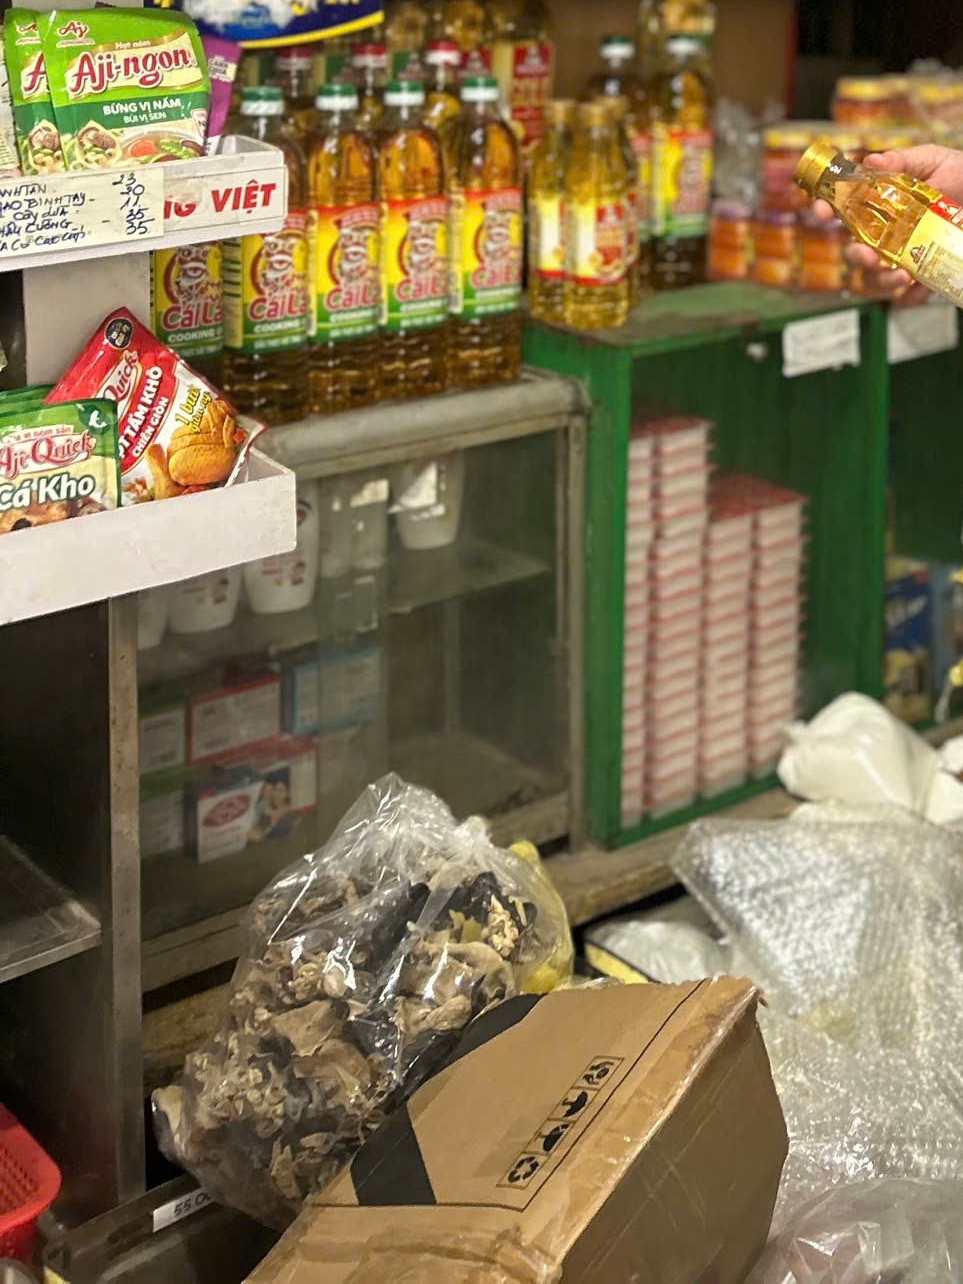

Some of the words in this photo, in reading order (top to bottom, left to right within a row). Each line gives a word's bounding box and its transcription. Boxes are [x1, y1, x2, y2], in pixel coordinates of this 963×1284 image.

[69, 47, 189, 93] Aji-ngon
[211, 179, 276, 214] VIỆT
[168, 329, 216, 343] COOKING
[141, 365, 163, 407] KHÔ
[38, 472, 96, 505] Kho
